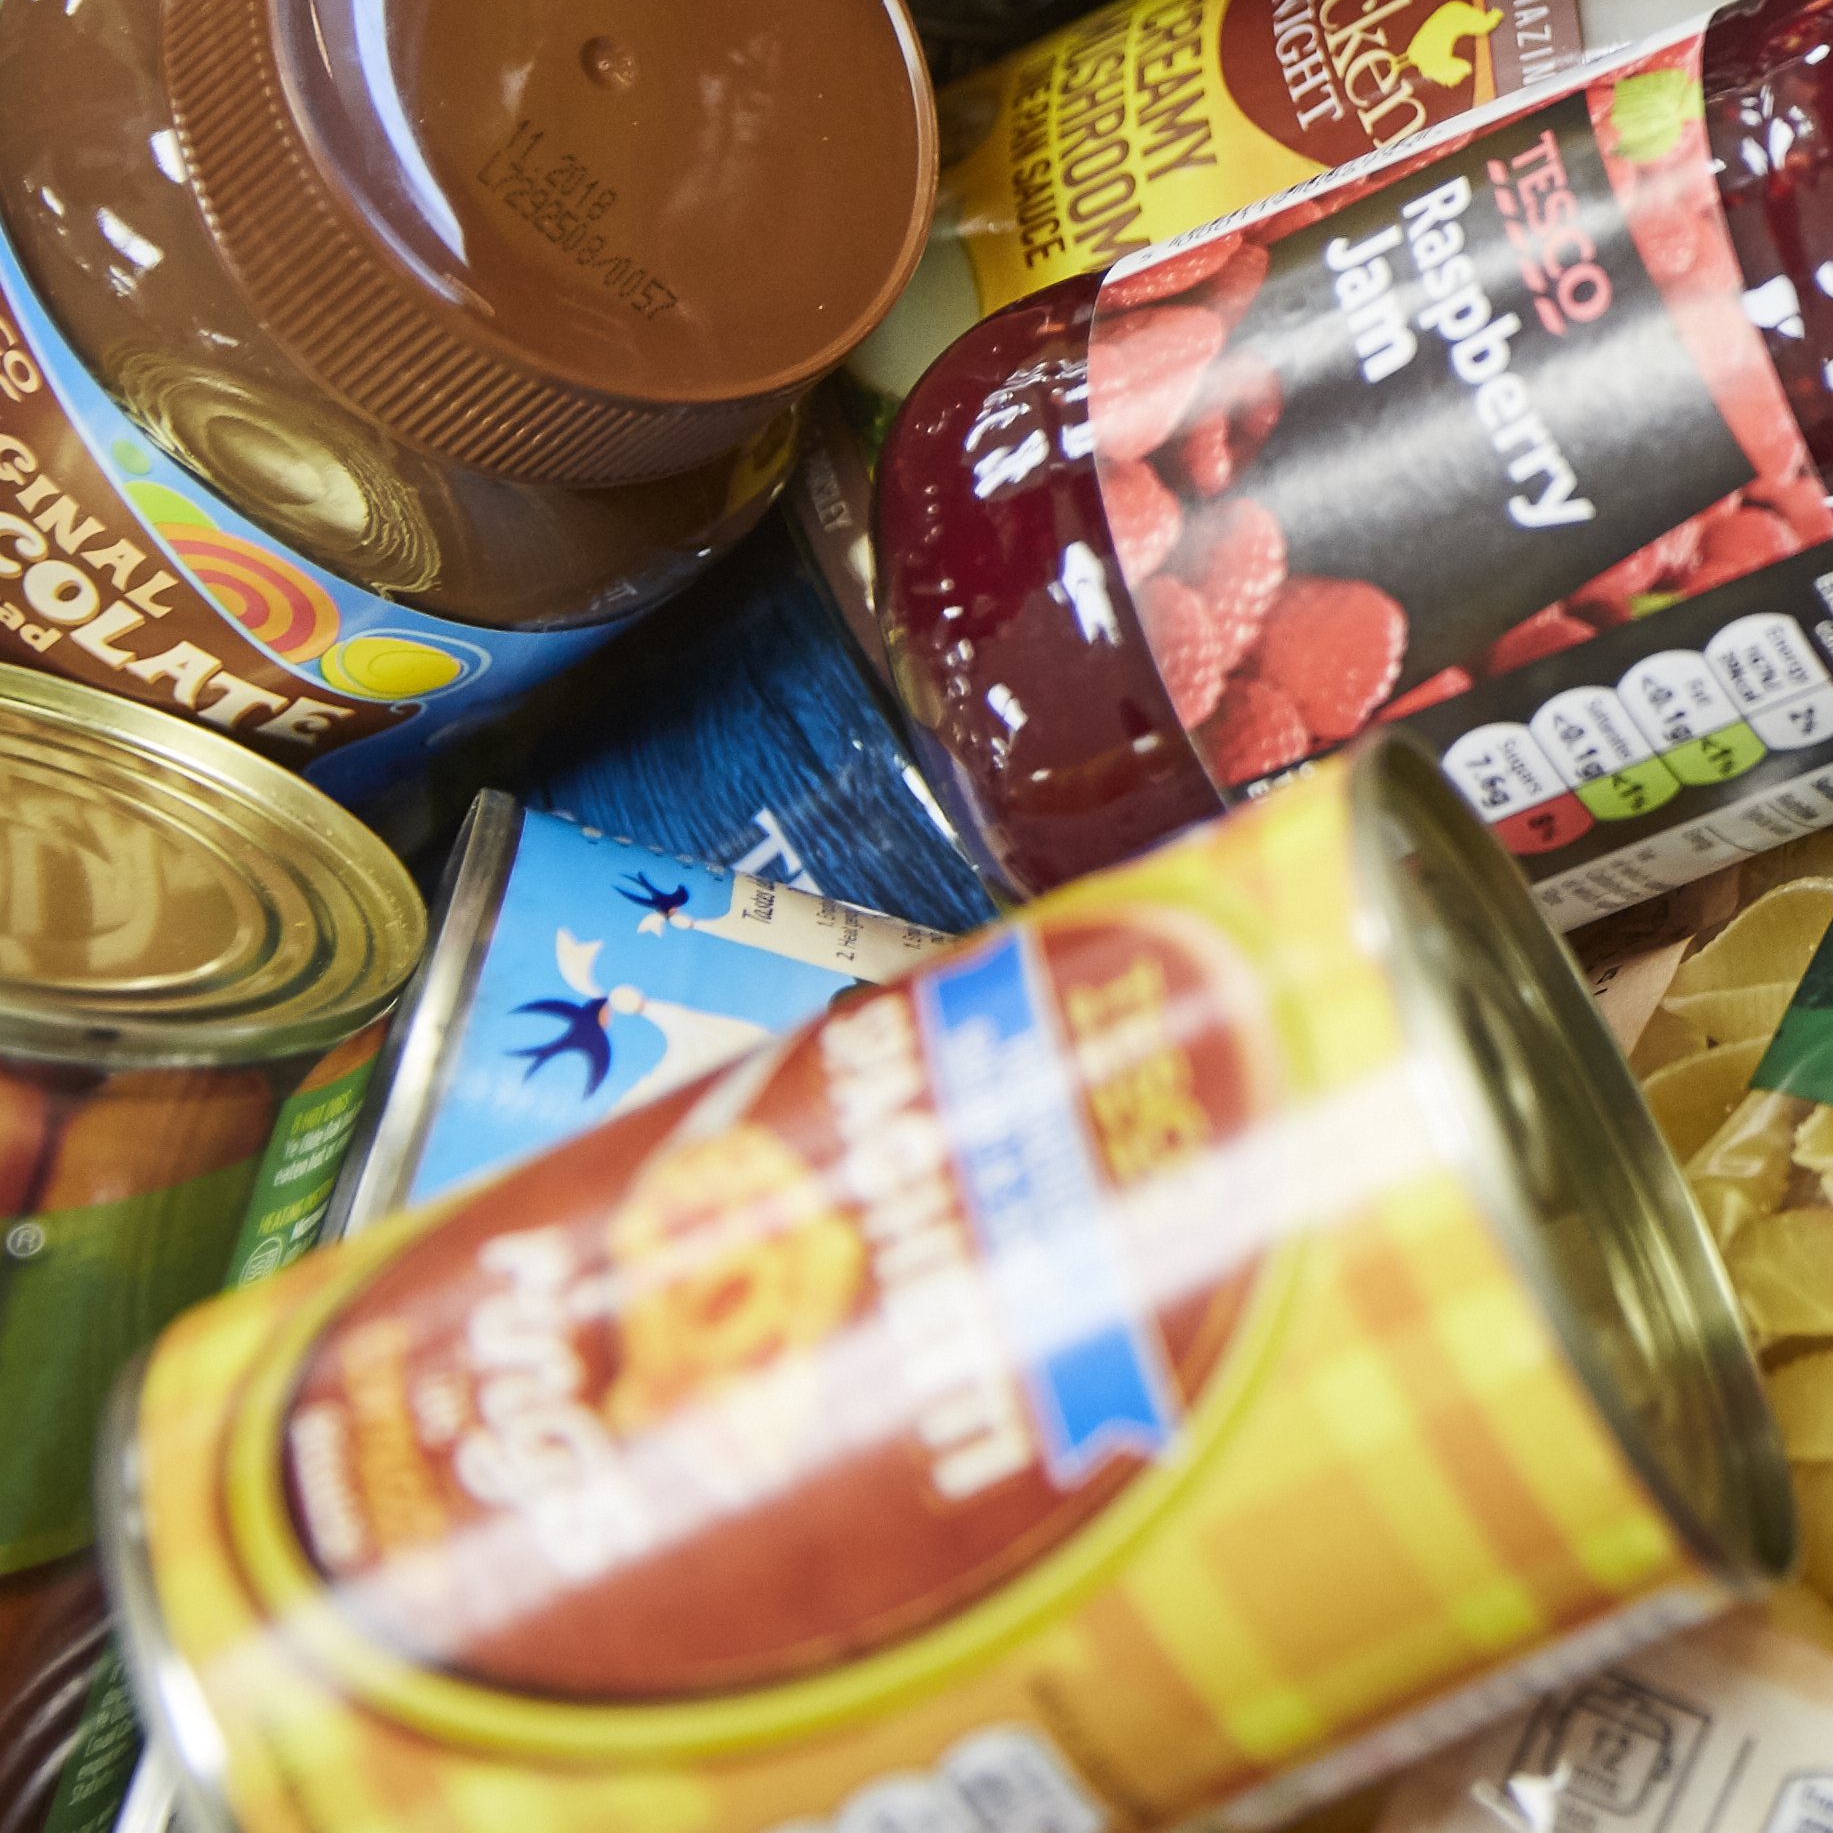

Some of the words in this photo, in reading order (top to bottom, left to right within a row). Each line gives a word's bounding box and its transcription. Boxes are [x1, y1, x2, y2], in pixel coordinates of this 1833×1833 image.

[1011, 155, 1068, 268] SAUCE
[1325, 222, 1420, 385] Jam
[1508, 129, 1615, 327] TESCO
[1400, 173, 1596, 529] Raspberry
[0, 433, 181, 619] GINAL
[0, 510, 357, 747] COLATE
